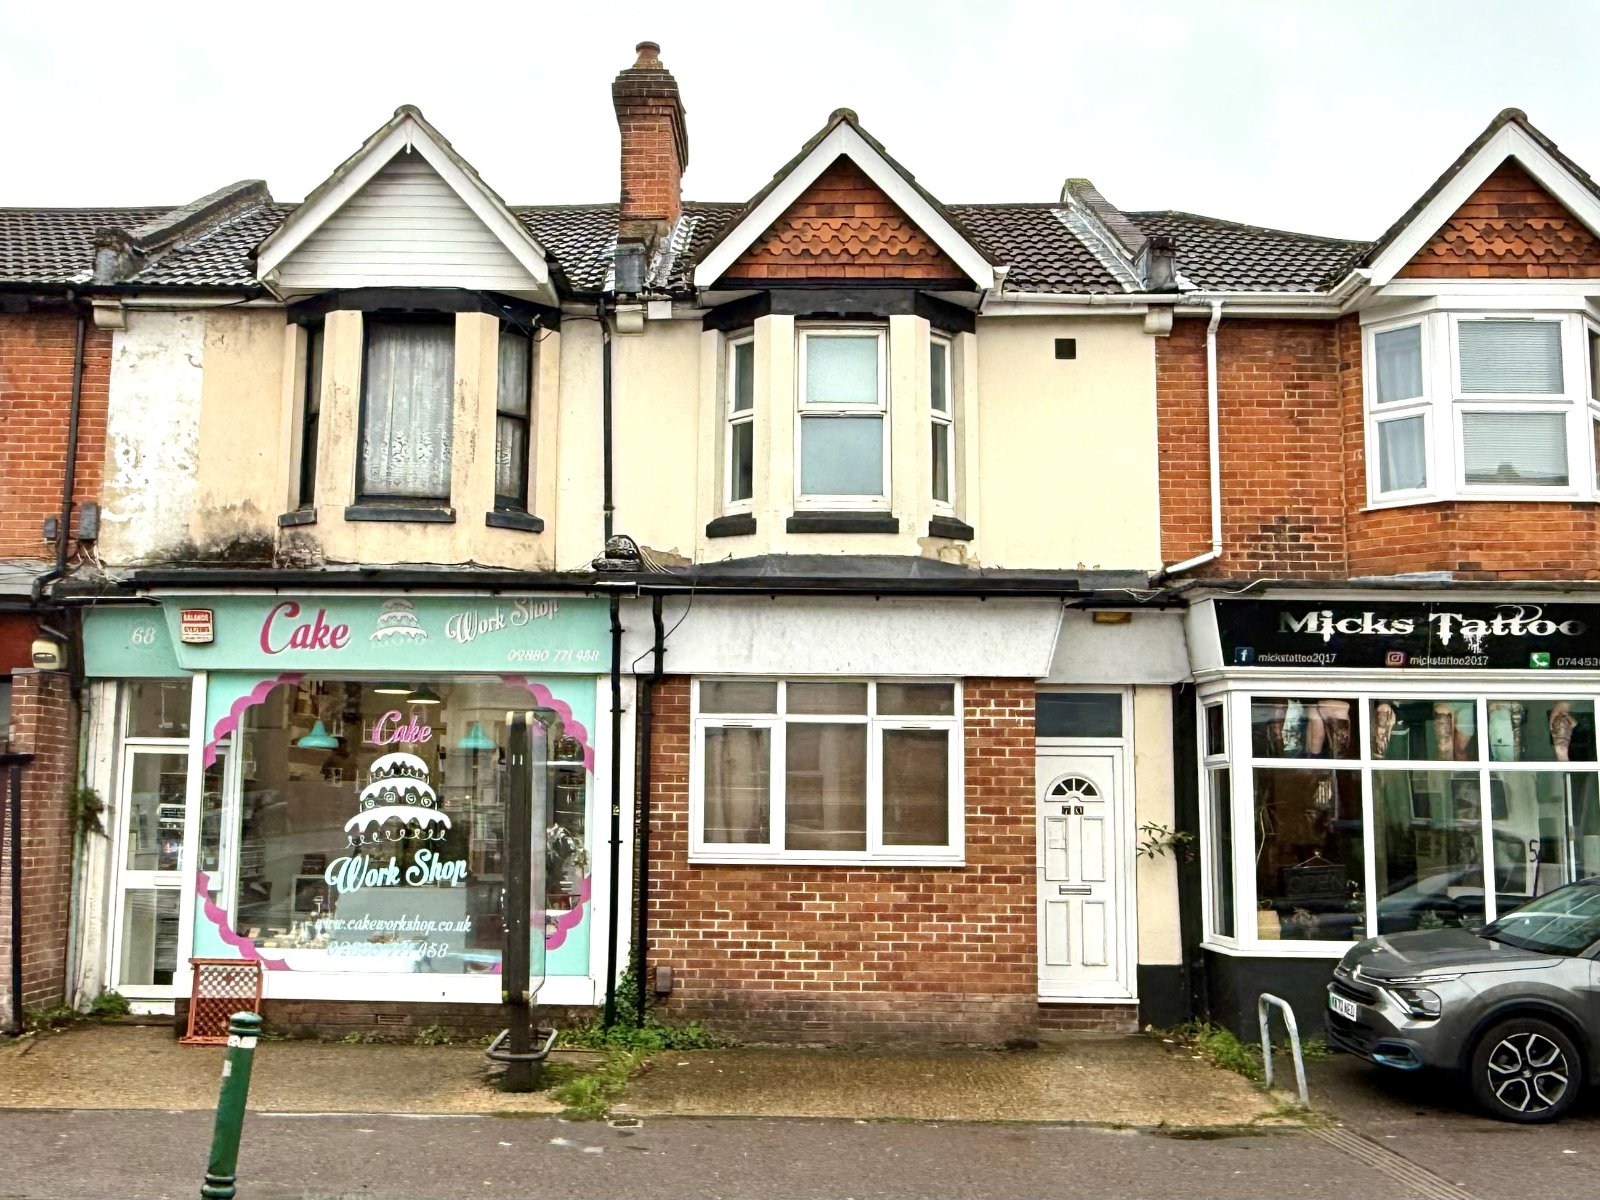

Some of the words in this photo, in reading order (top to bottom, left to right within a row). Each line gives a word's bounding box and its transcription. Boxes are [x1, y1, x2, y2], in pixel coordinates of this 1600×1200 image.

[131, 626, 156, 645] 68
[260, 600, 351, 655] Cake
[444, 605, 507, 645] Work
[511, 597, 560, 626] Shop
[1277, 609, 1415, 643] Micks
[1428, 604, 1587, 651] Tattoo
[1556, 657, 1600, 667] 074453
[371, 709, 433, 746] Cake
[324, 854, 401, 895] Work
[405, 848, 468, 887] Shop
[315, 913, 472, 936] www.cakeworkshop.co.uk
